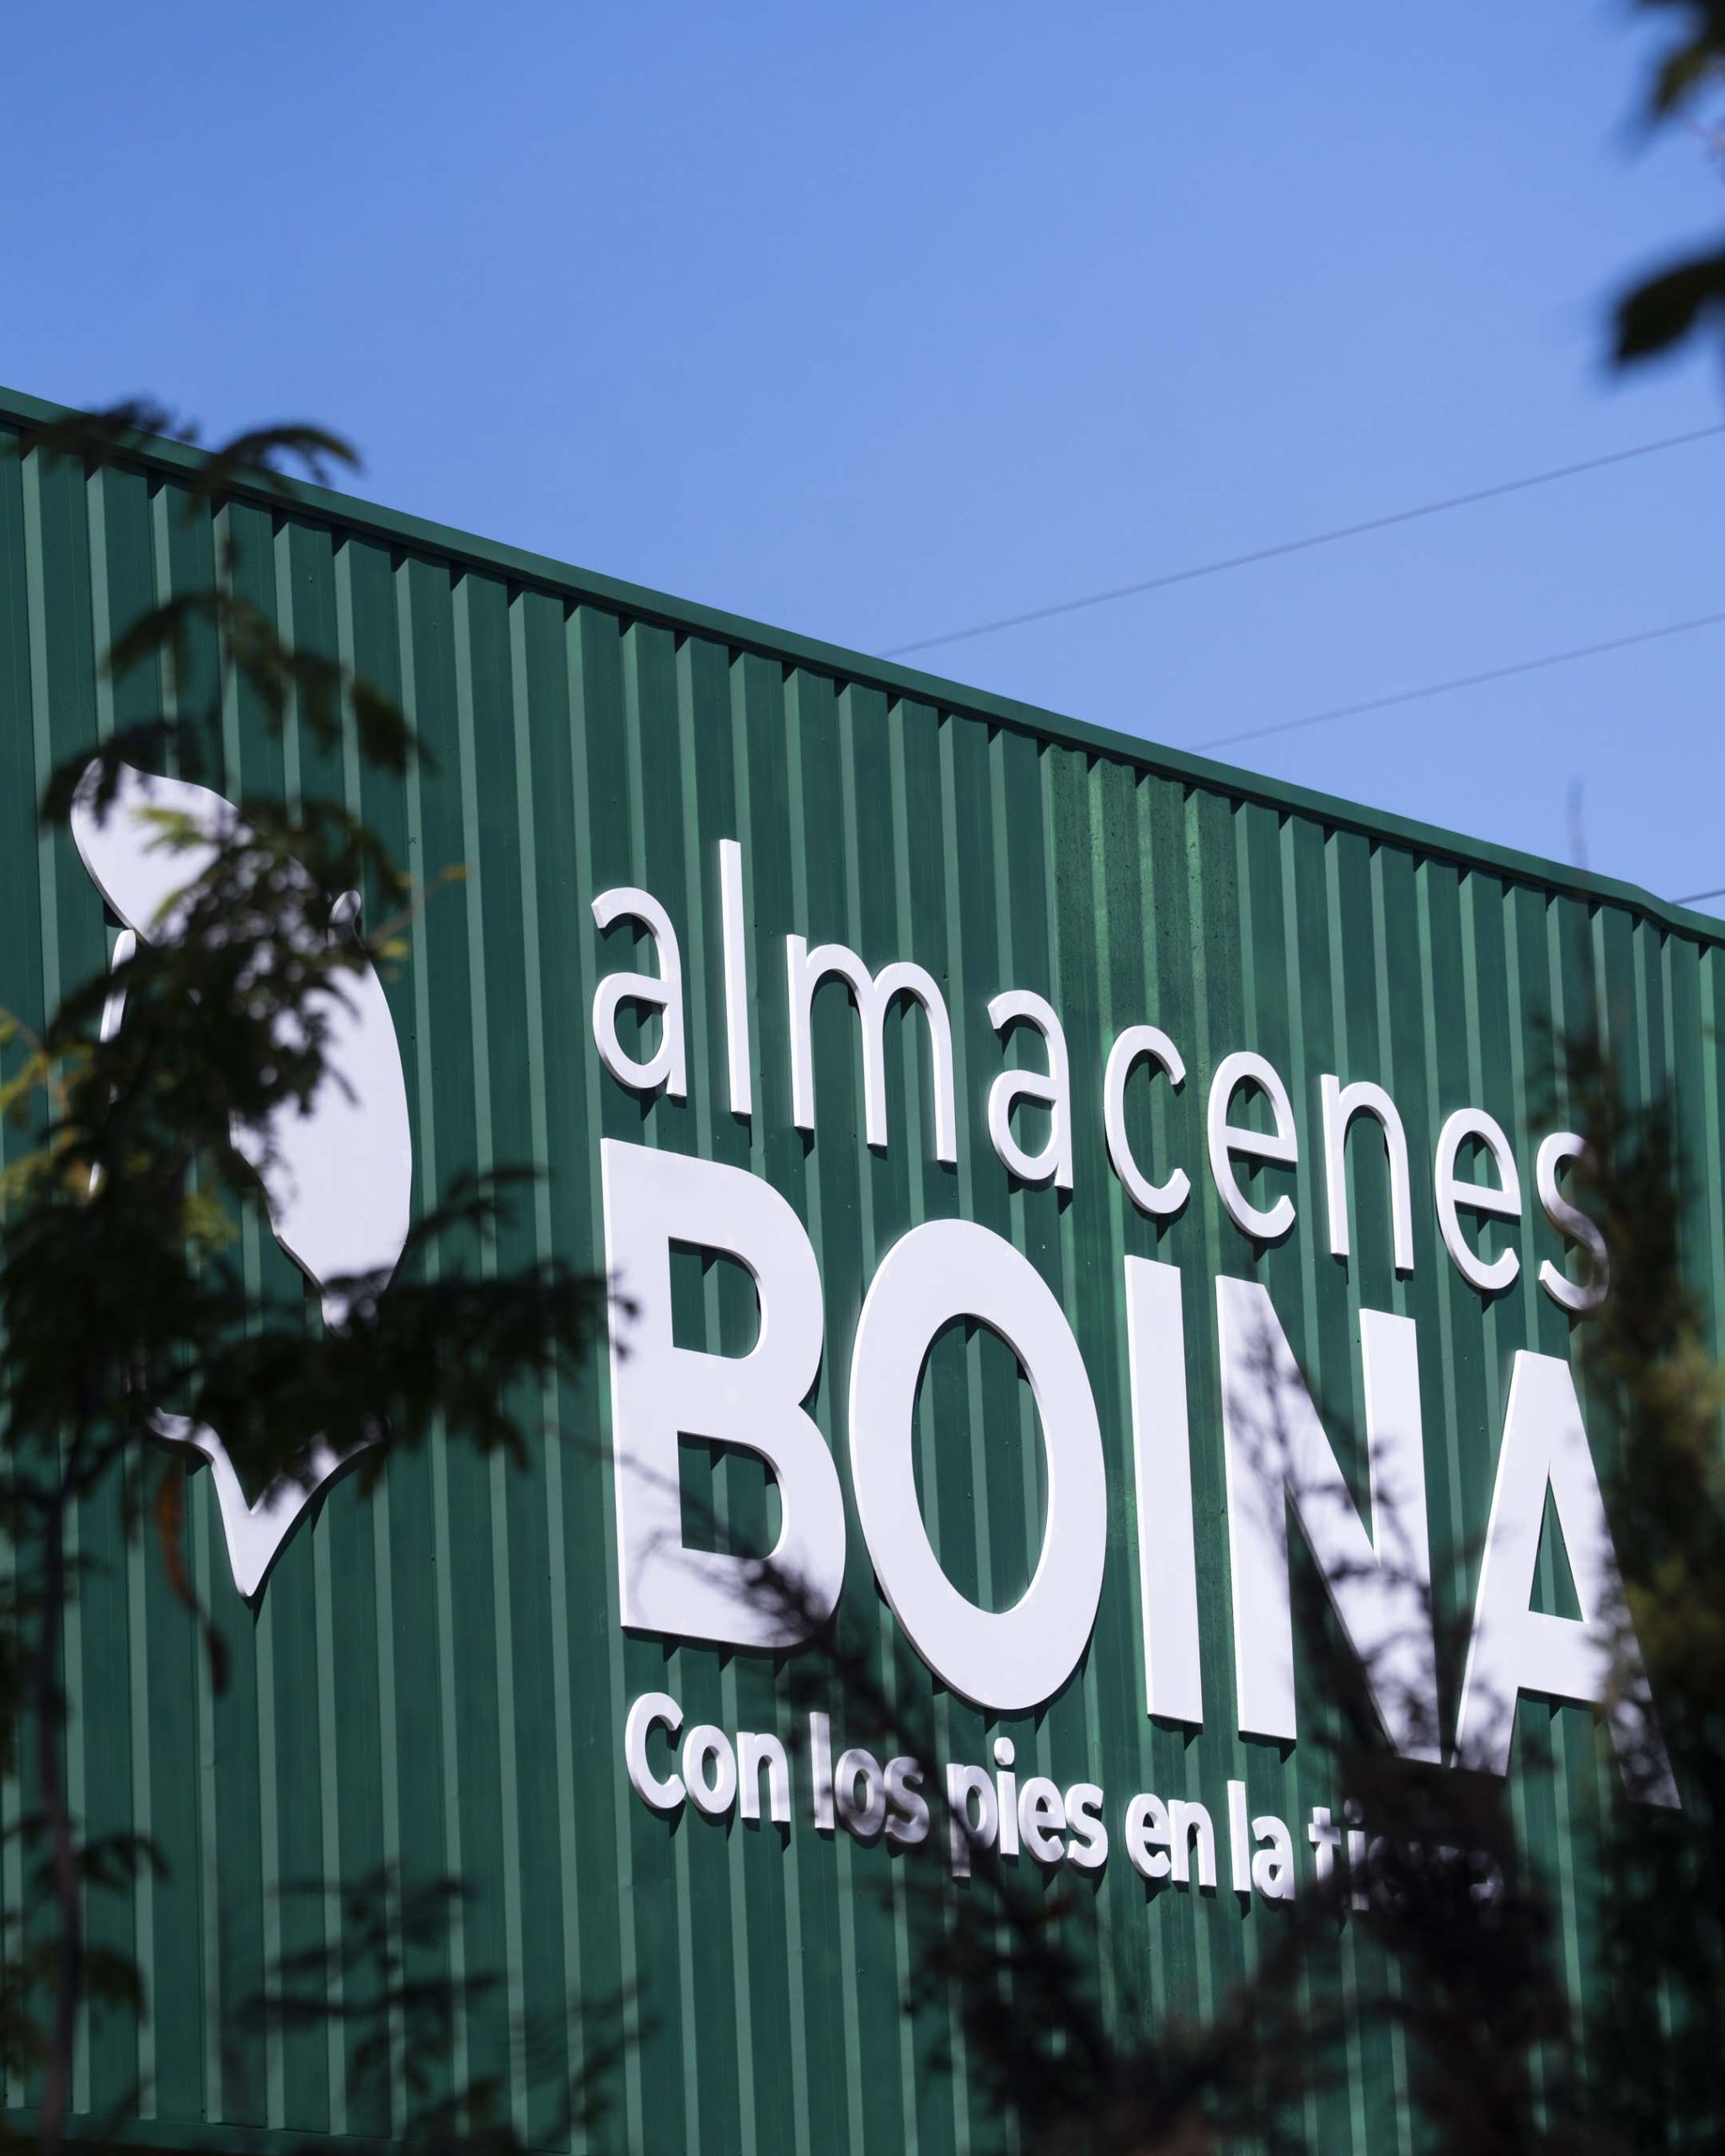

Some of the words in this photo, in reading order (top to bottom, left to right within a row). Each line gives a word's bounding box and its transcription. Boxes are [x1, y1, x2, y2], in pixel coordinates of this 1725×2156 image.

[591, 839, 1610, 1311] almacenes
[600, 1137, 1682, 1809] BOINA
[625, 1692, 790, 1822] Con
[809, 1711, 929, 1844] los
[946, 1737, 1108, 1877] pies
[1125, 1793, 1216, 1886] en
[1227, 1780, 1295, 1900] la
